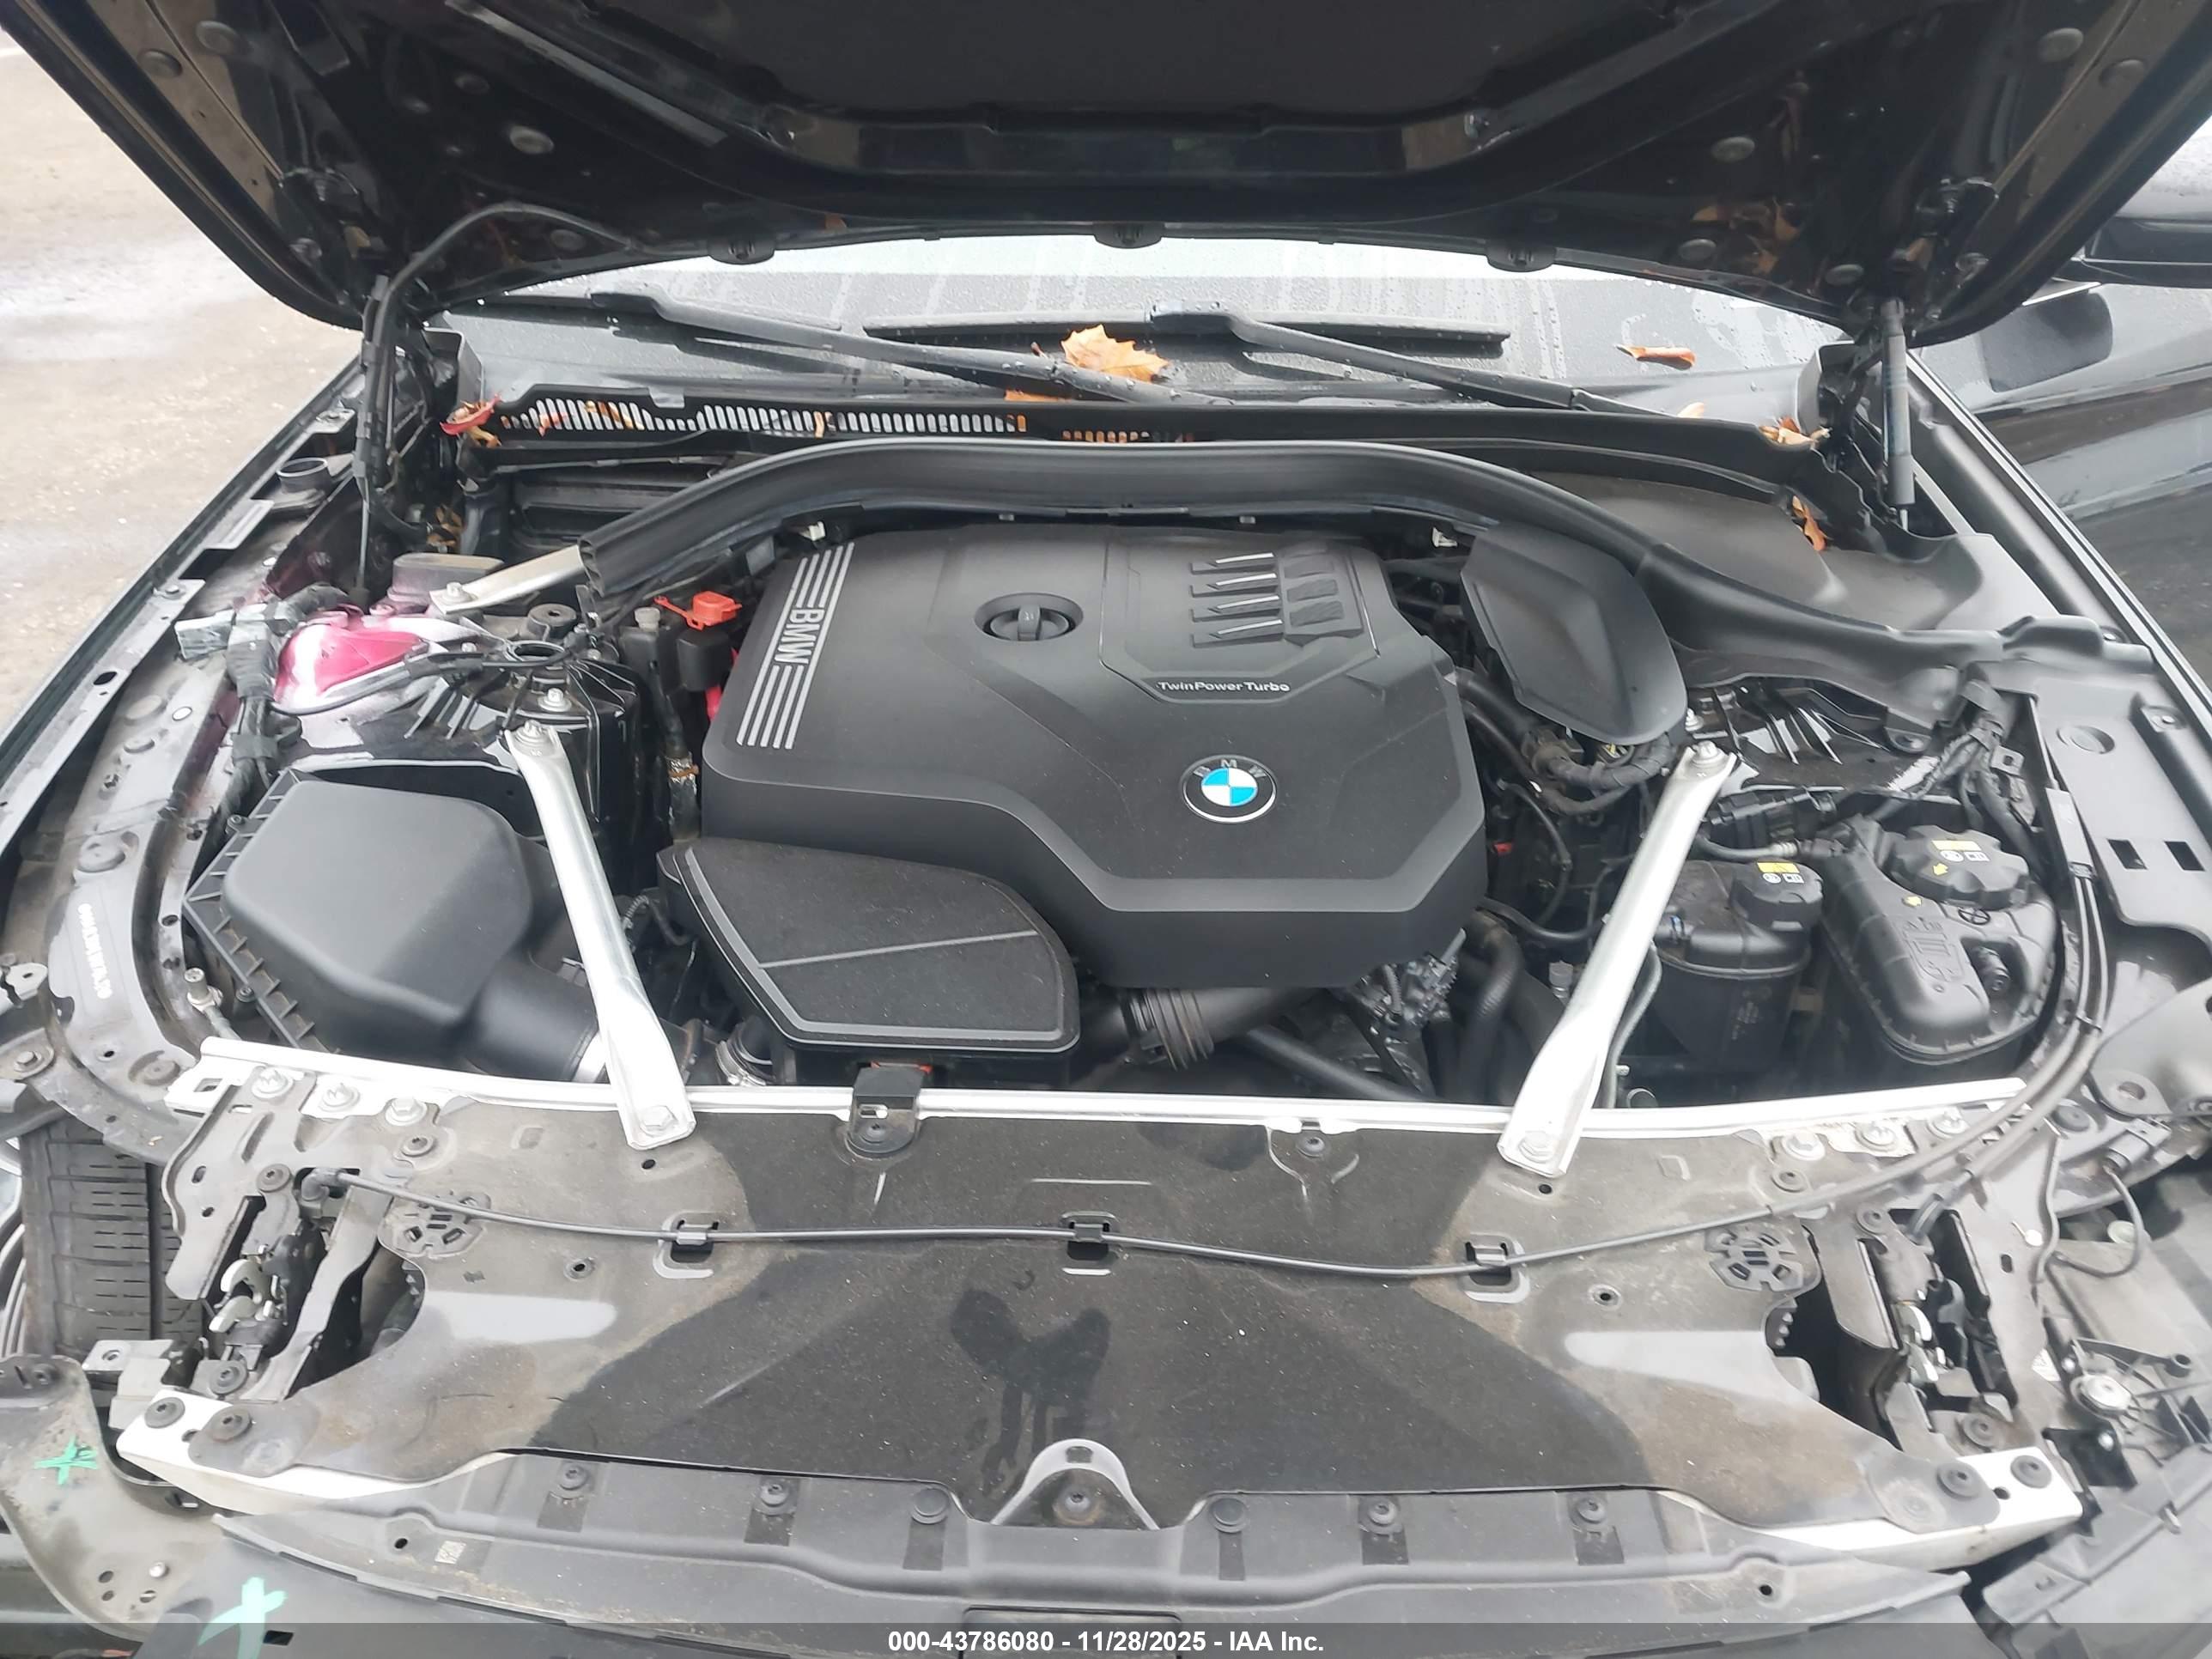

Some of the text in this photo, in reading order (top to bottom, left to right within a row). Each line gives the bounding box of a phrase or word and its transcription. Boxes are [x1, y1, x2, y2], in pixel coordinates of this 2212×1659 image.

[774, 610, 825, 665] BMW
[1158, 681, 1291, 692] TwinPower Turbo
